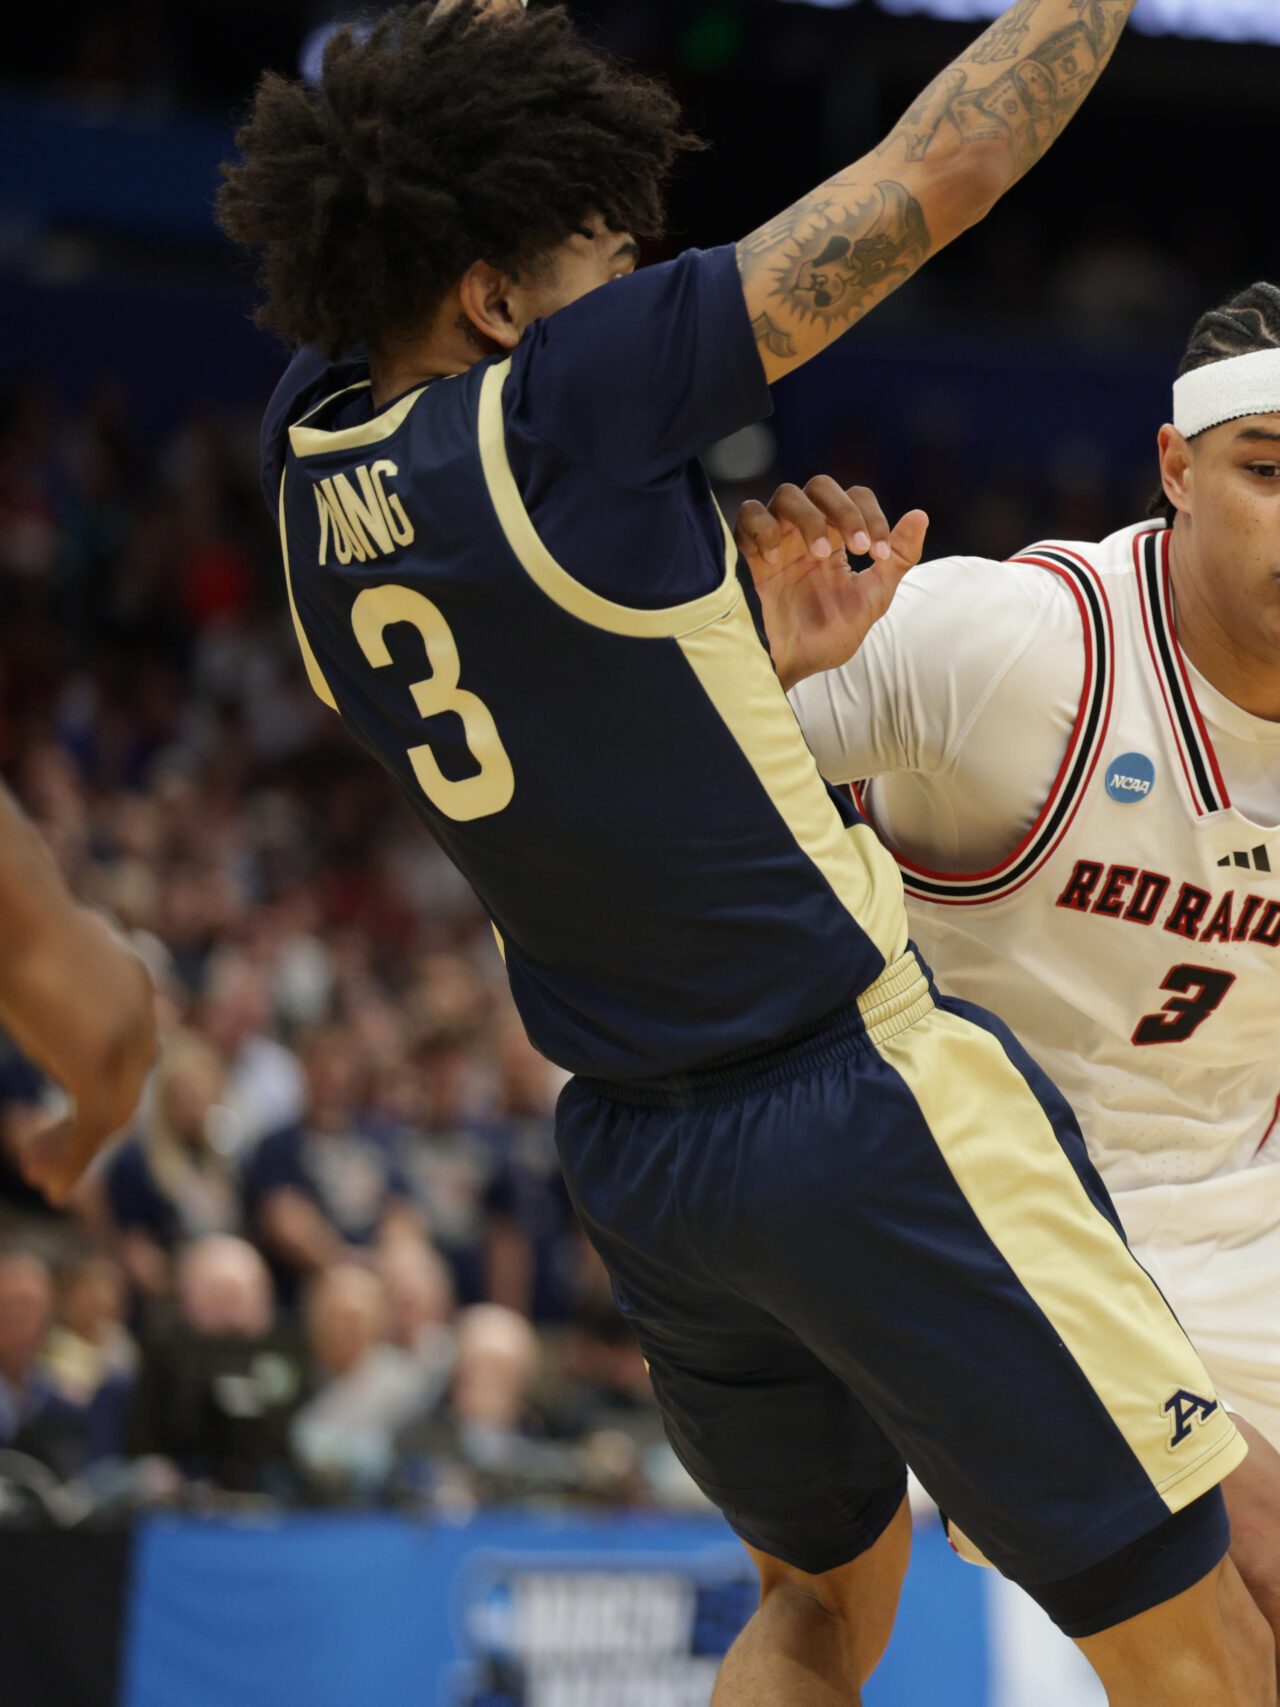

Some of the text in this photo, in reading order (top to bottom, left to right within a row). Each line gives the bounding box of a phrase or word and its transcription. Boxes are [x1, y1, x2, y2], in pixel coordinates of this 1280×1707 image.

[350, 583, 515, 822] 3
[1110, 773, 1150, 794] NCAA
[1056, 859, 1170, 926] RED
[1131, 963, 1237, 1046] 3
[1163, 1388, 1218, 1448] A
